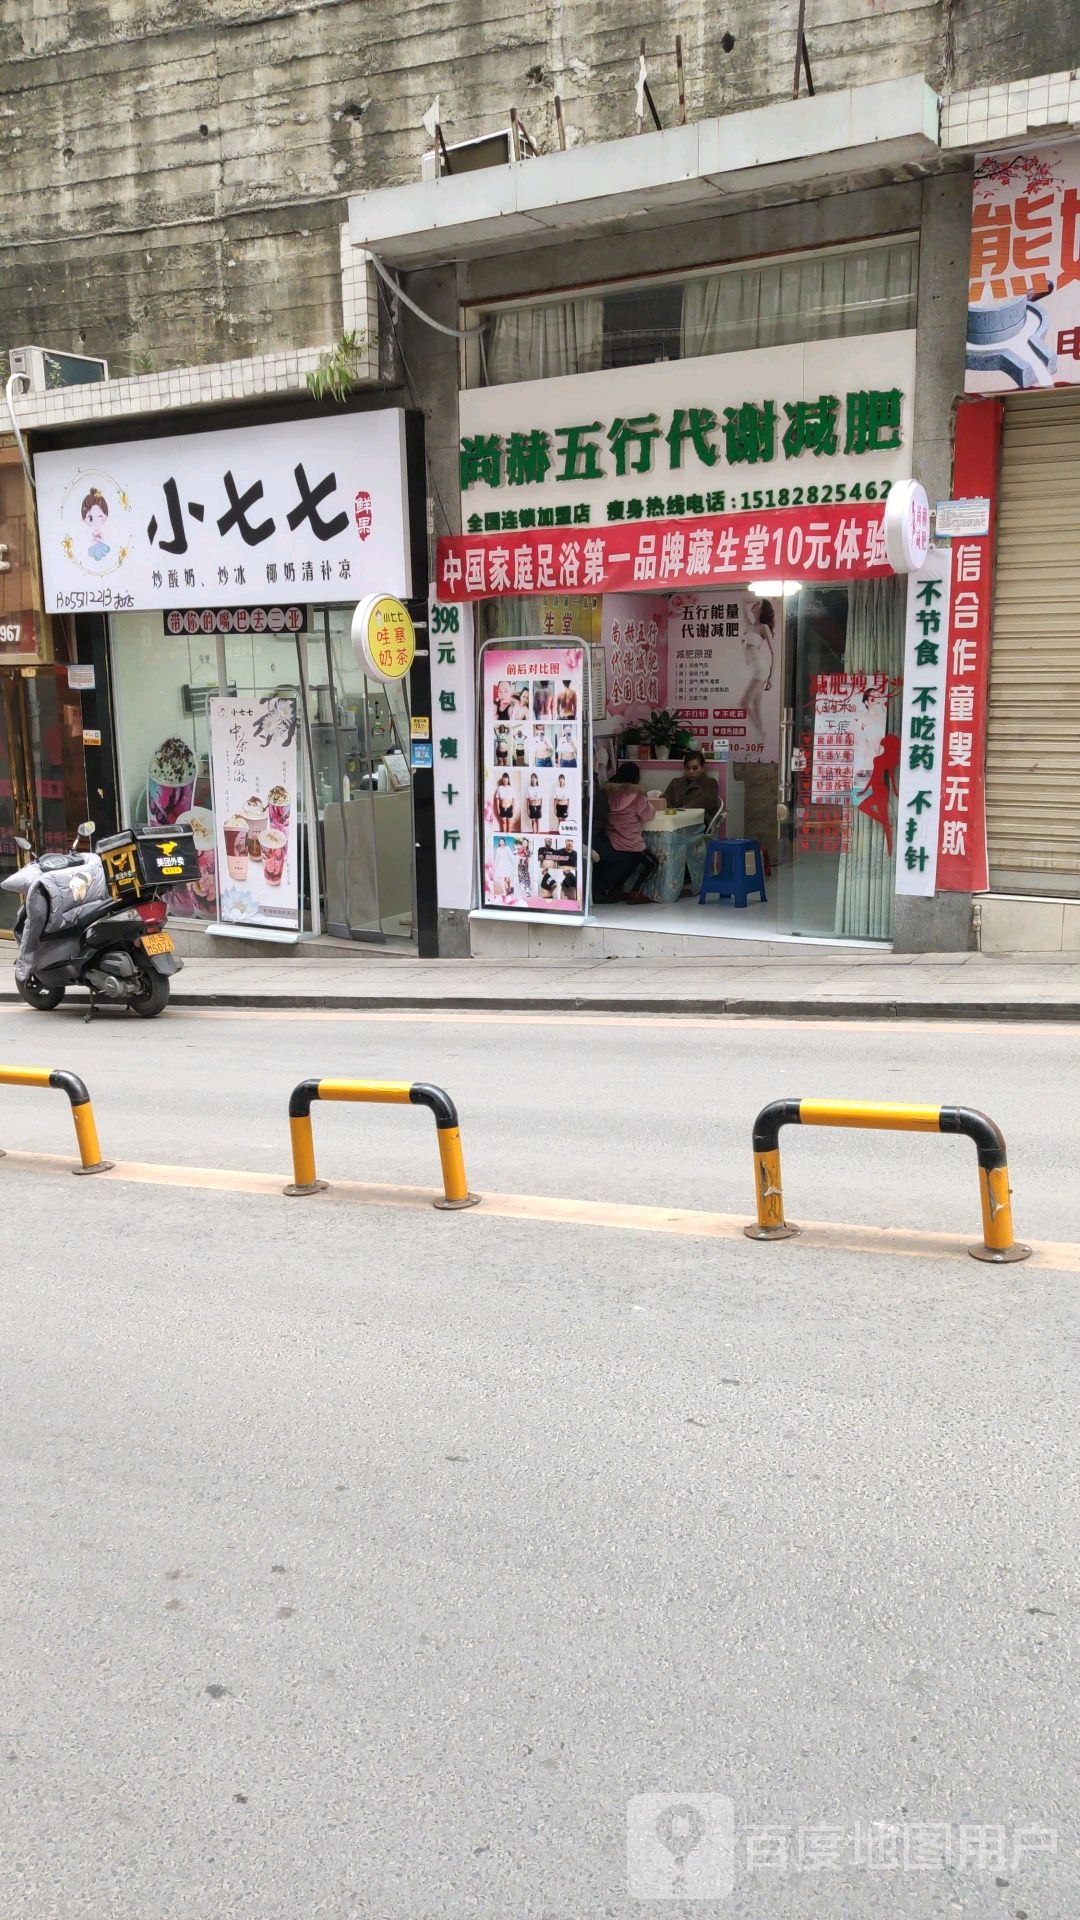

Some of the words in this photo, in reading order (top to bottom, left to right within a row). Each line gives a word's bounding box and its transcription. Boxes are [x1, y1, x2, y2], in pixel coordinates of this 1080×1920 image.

[460, 388, 903, 490] 尚赫五行代谢减肥
[147, 462, 349, 555] 小七七
[355, 494, 373, 535] 鲜果
[467, 502, 590, 532] 全国连锁加盟店
[443, 516, 888, 594] 中国家庭足浴第一品牌藏生堂10元体验
[266, 558, 351, 584] 椰奶清补凉
[167, 608, 302, 633] 带你的嘴巴去三亚
[682, 604, 739, 620] 五行能量
[914, 580, 942, 666] 不节食
[376, 627, 407, 646] 哇塞
[682, 623, 739, 638] 代谢减肥
[378, 649, 409, 667] 奶茶
[676, 649, 713, 659] 减肥原理
[506, 663, 560, 675] 前后对比图
[942, 497, 982, 857] 信合作童叟无欺
[231, 708, 253, 717] 小七七
[909, 686, 936, 771] 不吃药
[156, 856, 185, 868] 美团外卖
